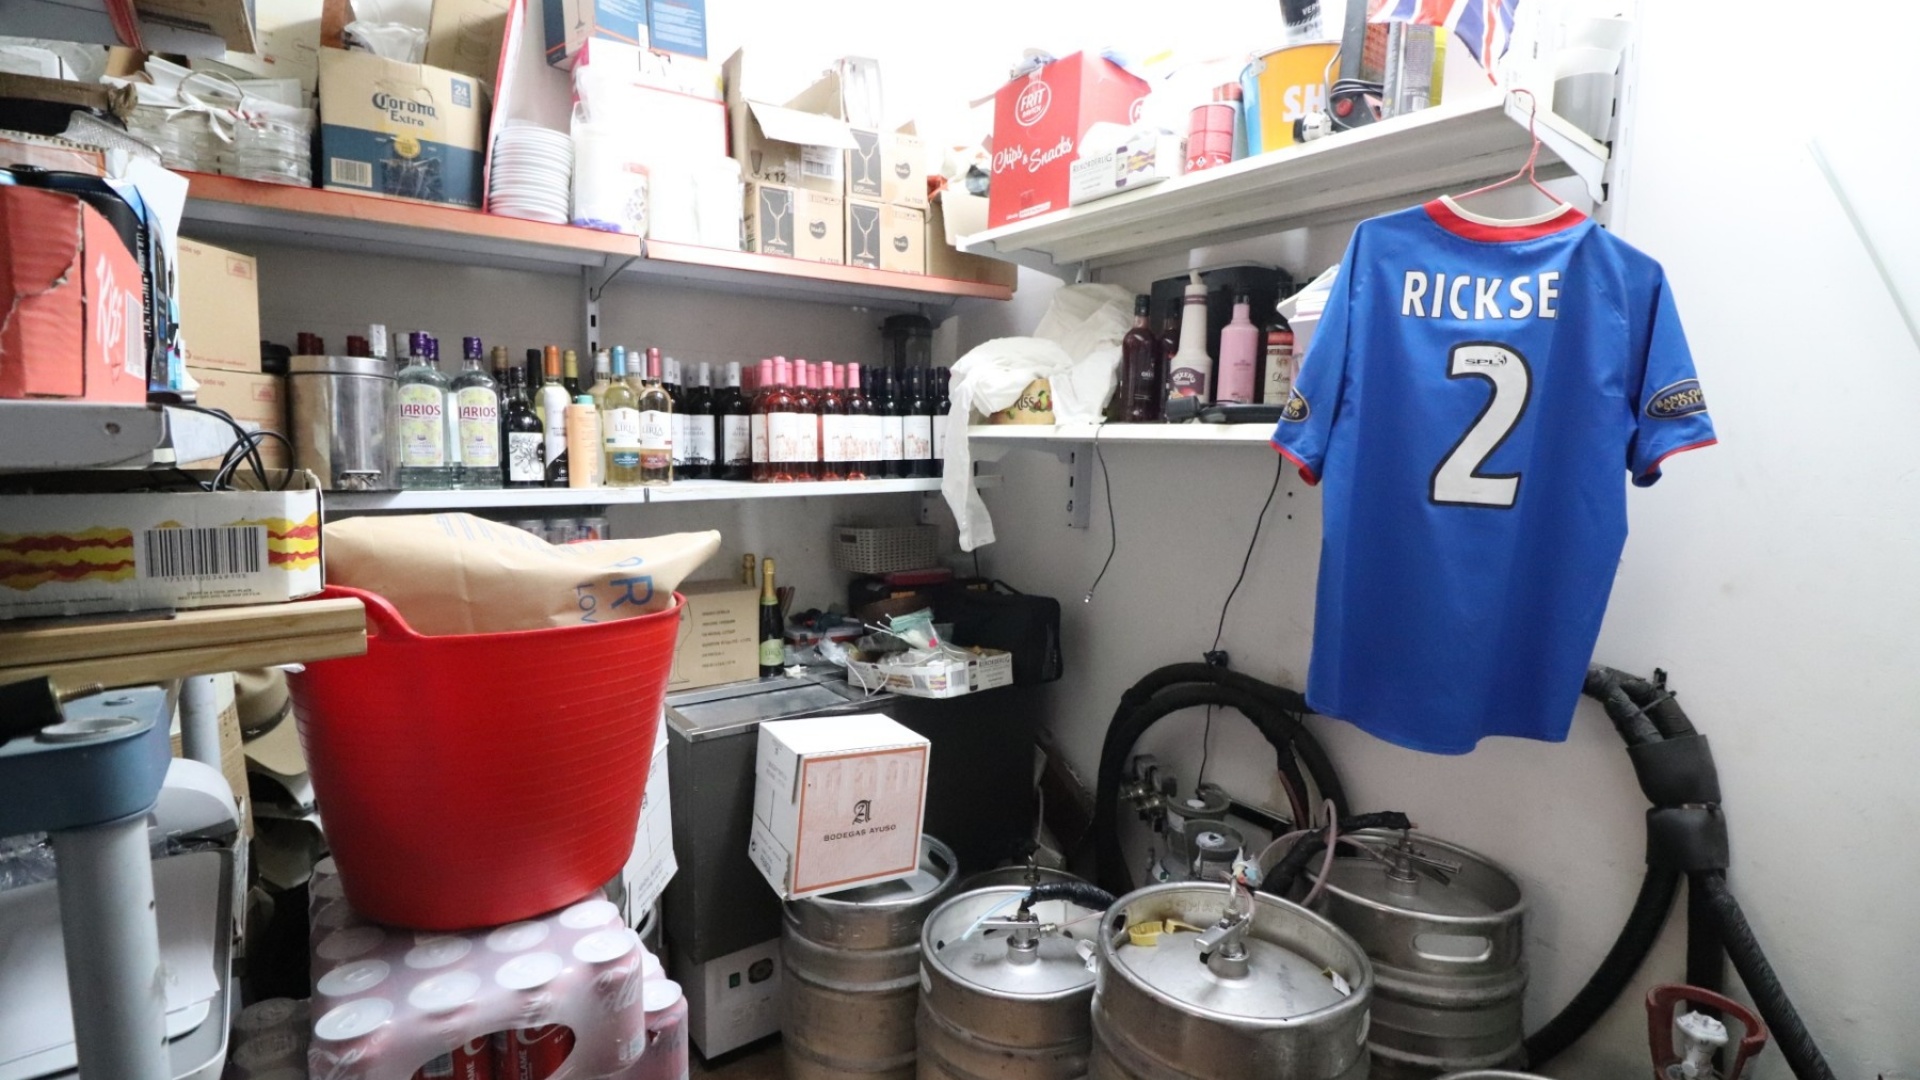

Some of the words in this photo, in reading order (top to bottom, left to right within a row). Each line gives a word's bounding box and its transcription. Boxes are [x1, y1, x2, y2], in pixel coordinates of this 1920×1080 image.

[454, 85, 467, 97] 24
[1020, 87, 1046, 111] FRIT
[371, 92, 437, 118] Corona
[390, 110, 424, 126] Extra
[993, 145, 1023, 174] Chips
[1028, 135, 1073, 173] Snacks
[774, 172, 786, 184] 12
[1400, 270, 1561, 320] RICKSE
[1464, 358, 1501, 367] SPL
[400, 404, 441, 417] LARIOS
[459, 406, 496, 419] LARIOS
[1428, 341, 1533, 510] 2
[823, 829, 867, 842] BODEGAS
[868, 823, 898, 834] AYUSO
